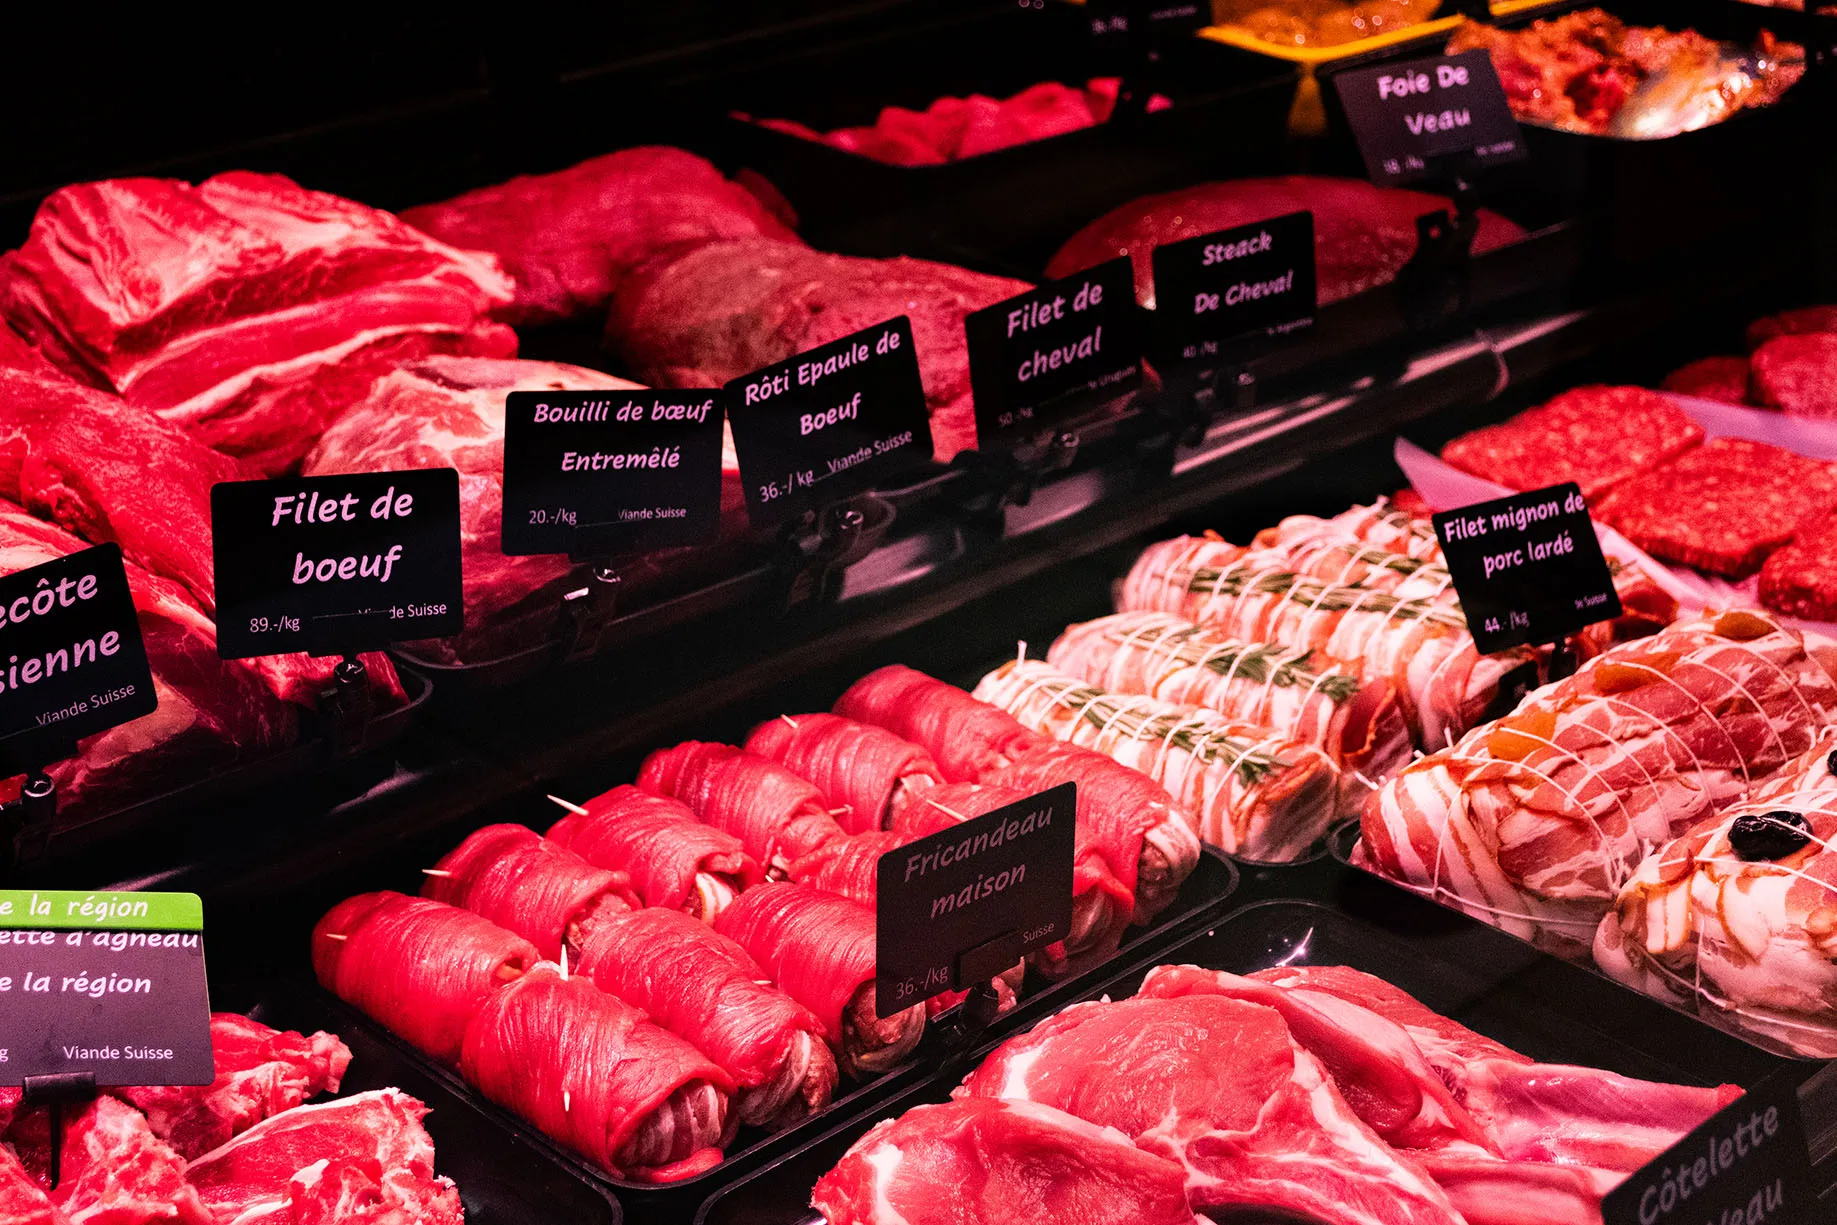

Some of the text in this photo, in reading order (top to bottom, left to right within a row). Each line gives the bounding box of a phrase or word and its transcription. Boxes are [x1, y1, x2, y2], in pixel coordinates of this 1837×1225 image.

[1377, 65, 1470, 100] Foie De
[1404, 108, 1472, 135] Veau
[1201, 229, 1273, 266] Steack
[1007, 281, 1104, 339] Filet de
[1193, 268, 1295, 315] De Cheval
[745, 330, 901, 406] Rôti Epaule de
[1017, 325, 1103, 382] cheval
[533, 400, 611, 423] Bouilli
[615, 400, 644, 422] de
[799, 391, 862, 437] Boeuf
[560, 445, 681, 472] Entremêlé
[826, 446, 873, 475] Viande
[873, 430, 913, 456] Suisse
[271, 485, 414, 527] Filet de
[528, 506, 687, 526] 20.-/kg Viande Suisse
[1443, 491, 1586, 543] Filet mignon de
[291, 544, 404, 585] boeuf
[1482, 530, 1575, 580] porc lardé
[249, 614, 301, 634] 89.-/kg
[407, 602, 447, 618] Suisse
[35, 683, 136, 727] Viande Suisse
[903, 806, 1053, 884] Fricandeau
[29, 891, 52, 917] la
[67, 894, 149, 922] région
[929, 863, 1027, 920] maison
[895, 922, 1056, 1000] 36.-/kg Suisse
[23, 971, 52, 993] la
[61, 970, 152, 998] région
[62, 1045, 120, 1060] Viande
[124, 1045, 174, 1060] Suisse
[1639, 1104, 1779, 1225] Côtelette
